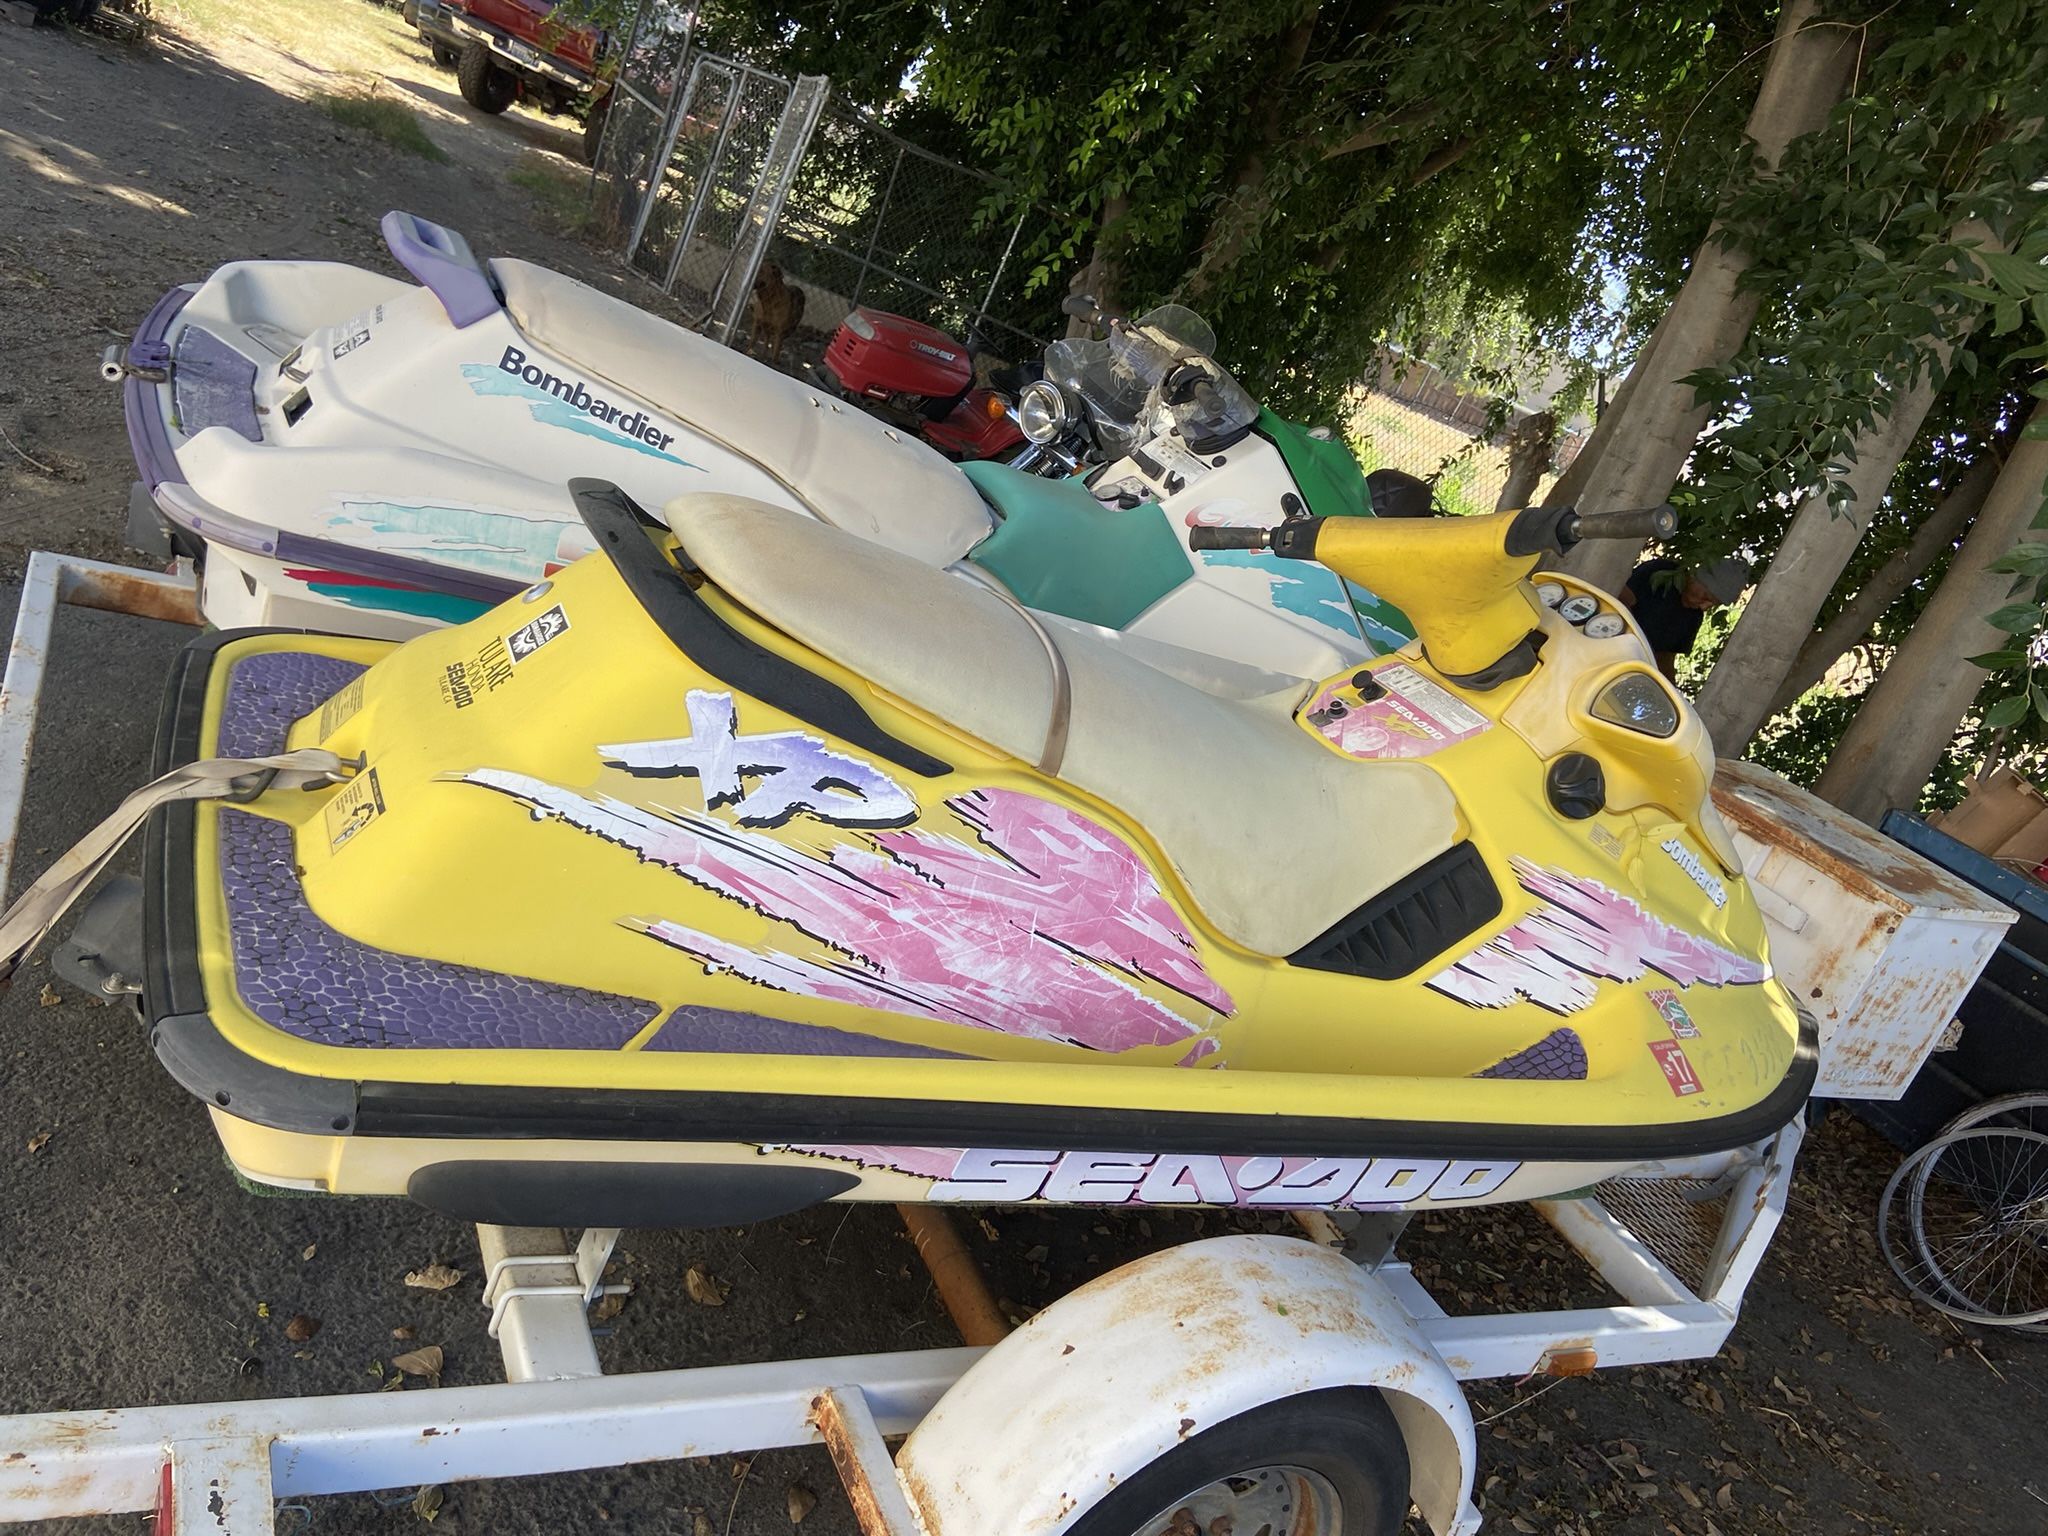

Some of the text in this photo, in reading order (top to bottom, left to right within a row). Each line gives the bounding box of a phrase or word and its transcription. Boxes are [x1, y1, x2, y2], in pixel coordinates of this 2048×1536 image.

[498, 345, 676, 453] Bombardier
[465, 659, 487, 695] HONDA
[478, 635, 514, 692] TULARE
[1666, 1049, 1693, 1084] 17
